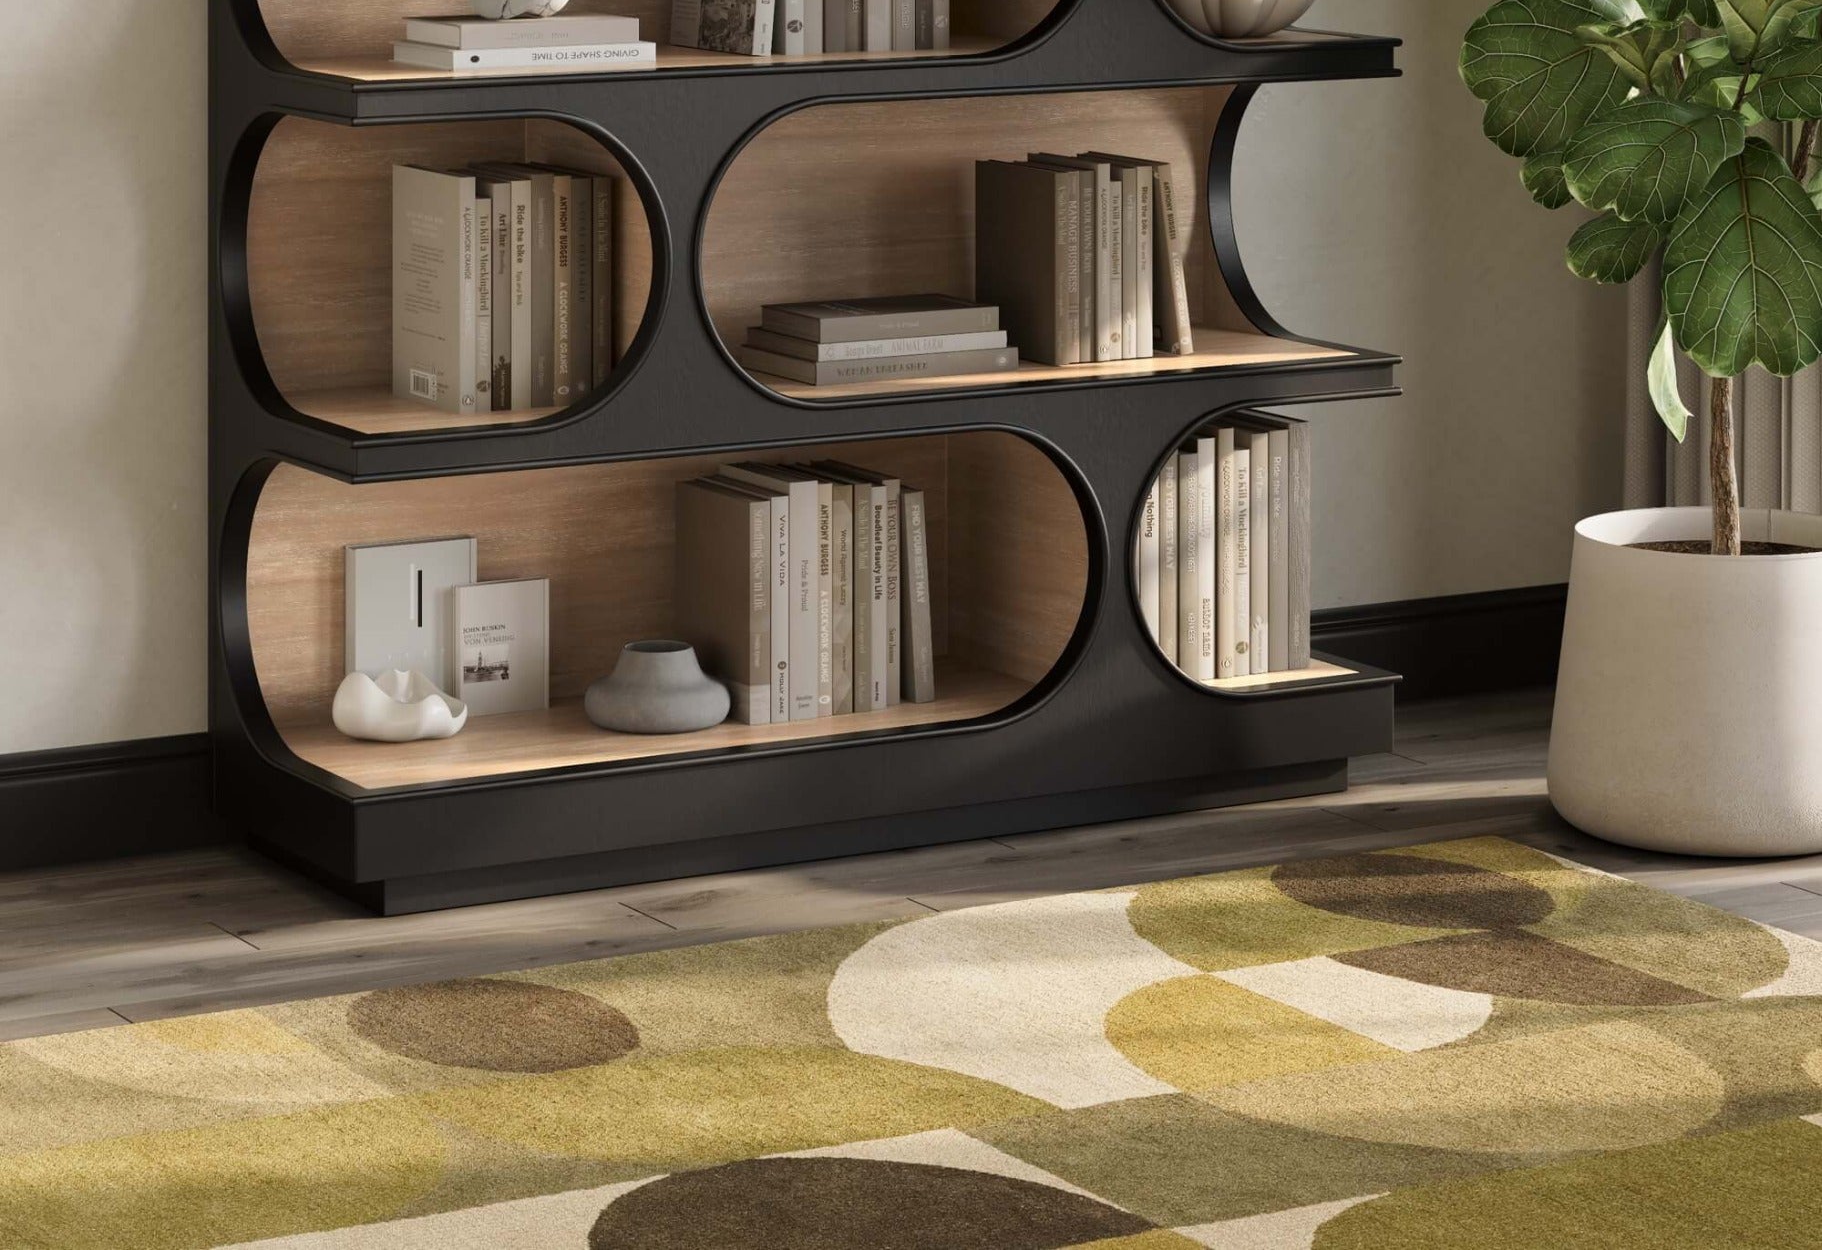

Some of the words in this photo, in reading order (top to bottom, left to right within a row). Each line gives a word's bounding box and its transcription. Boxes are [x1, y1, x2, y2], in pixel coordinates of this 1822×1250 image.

[531, 53, 553, 61] TIME
[555, 52, 568, 60] TO
[571, 51, 601, 59] SHAPE
[603, 49, 640, 58] GIVING
[1111, 194, 1120, 205] To
[1141, 186, 1149, 205] Ride
[1162, 181, 1174, 212] ANTHONY
[479, 214, 489, 227] To
[498, 212, 507, 226] Art
[516, 204, 525, 225] Ride
[559, 196, 568, 232] ANTHONY
[1068, 200, 1078, 243] MANAGE
[1111, 206, 1120, 220] Kill
[1141, 206, 1149, 218] the
[479, 228, 489, 245] Kill
[498, 228, 507, 247] Line
[516, 227, 525, 243] the
[1141, 219, 1149, 236] bike
[516, 244, 525, 263] bike
[559, 235, 568, 268] BURGESS
[1111, 228, 1120, 275] Mockingbird
[479, 253, 489, 311] Mockingbird
[1068, 245, 1078, 294] BUSINESS
[559, 289, 569, 340] CLOCKWORK
[559, 342, 569, 375] ORANGE
[1237, 466, 1247, 480] To
[1237, 481, 1247, 498] Kill
[887, 500, 897, 511] BE
[911, 504, 922, 527] FIND
[820, 504, 829, 541] ANTHONY
[873, 504, 883, 544] Broadleaf
[887, 513, 897, 542] YOUR
[1145, 501, 1154, 538] Nothing
[912, 528, 923, 555] YOUR
[1237, 508, 1247, 569] Mockingbird
[820, 543, 829, 576] BURGESS
[873, 546, 883, 574] Beauty
[887, 544, 897, 573] OWN
[914, 556, 925, 580] BEST
[873, 585, 883, 600] Life
[887, 575, 897, 600] BOSS
[820, 600, 829, 649] CLOCKWORK
[1202, 598, 1211, 629] author
[1202, 631, 1211, 657] name
[820, 651, 829, 683] ORANGE
